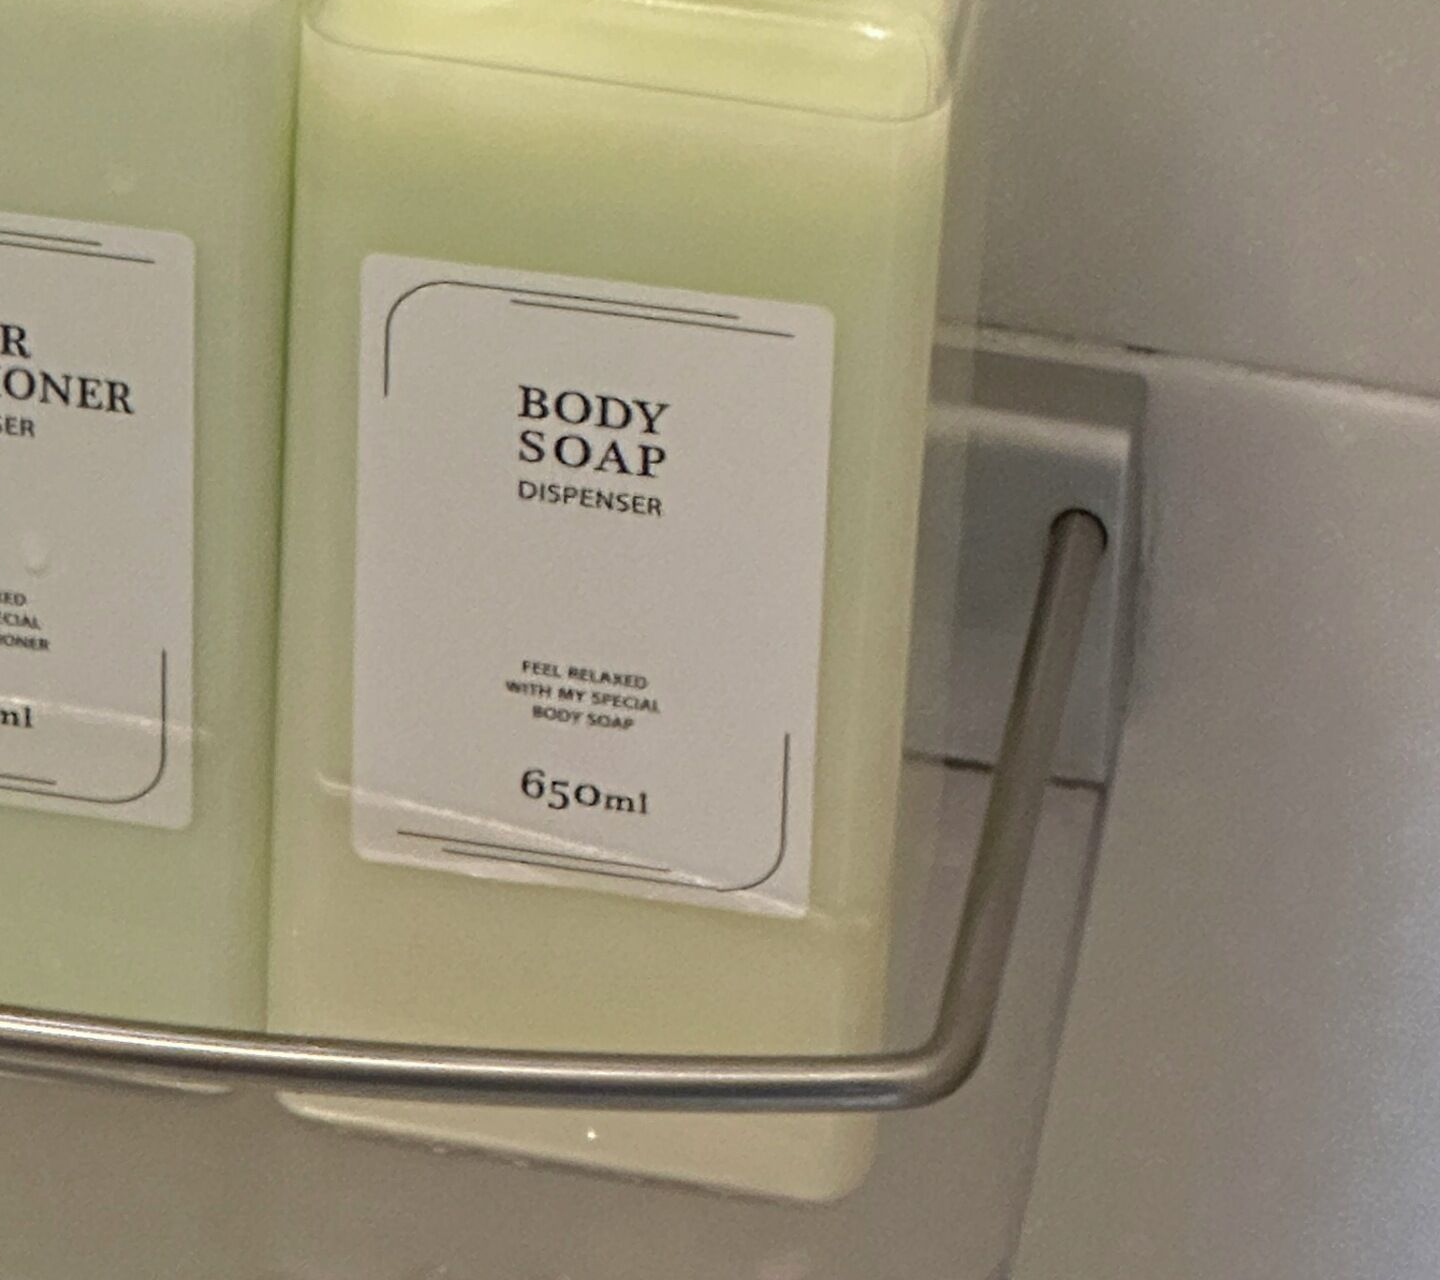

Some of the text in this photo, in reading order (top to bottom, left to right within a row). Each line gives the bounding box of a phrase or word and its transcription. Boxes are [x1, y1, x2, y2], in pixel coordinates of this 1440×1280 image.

[517, 384, 670, 435] BODY
[518, 429, 666, 478] SOAP
[518, 480, 662, 517] DISPENSER
[521, 660, 648, 690] FEEL RELAXED
[505, 681, 659, 713] WITH MY SPECIAL
[532, 705, 634, 730] BODY SOAP
[520, 767, 650, 815] 650ml
